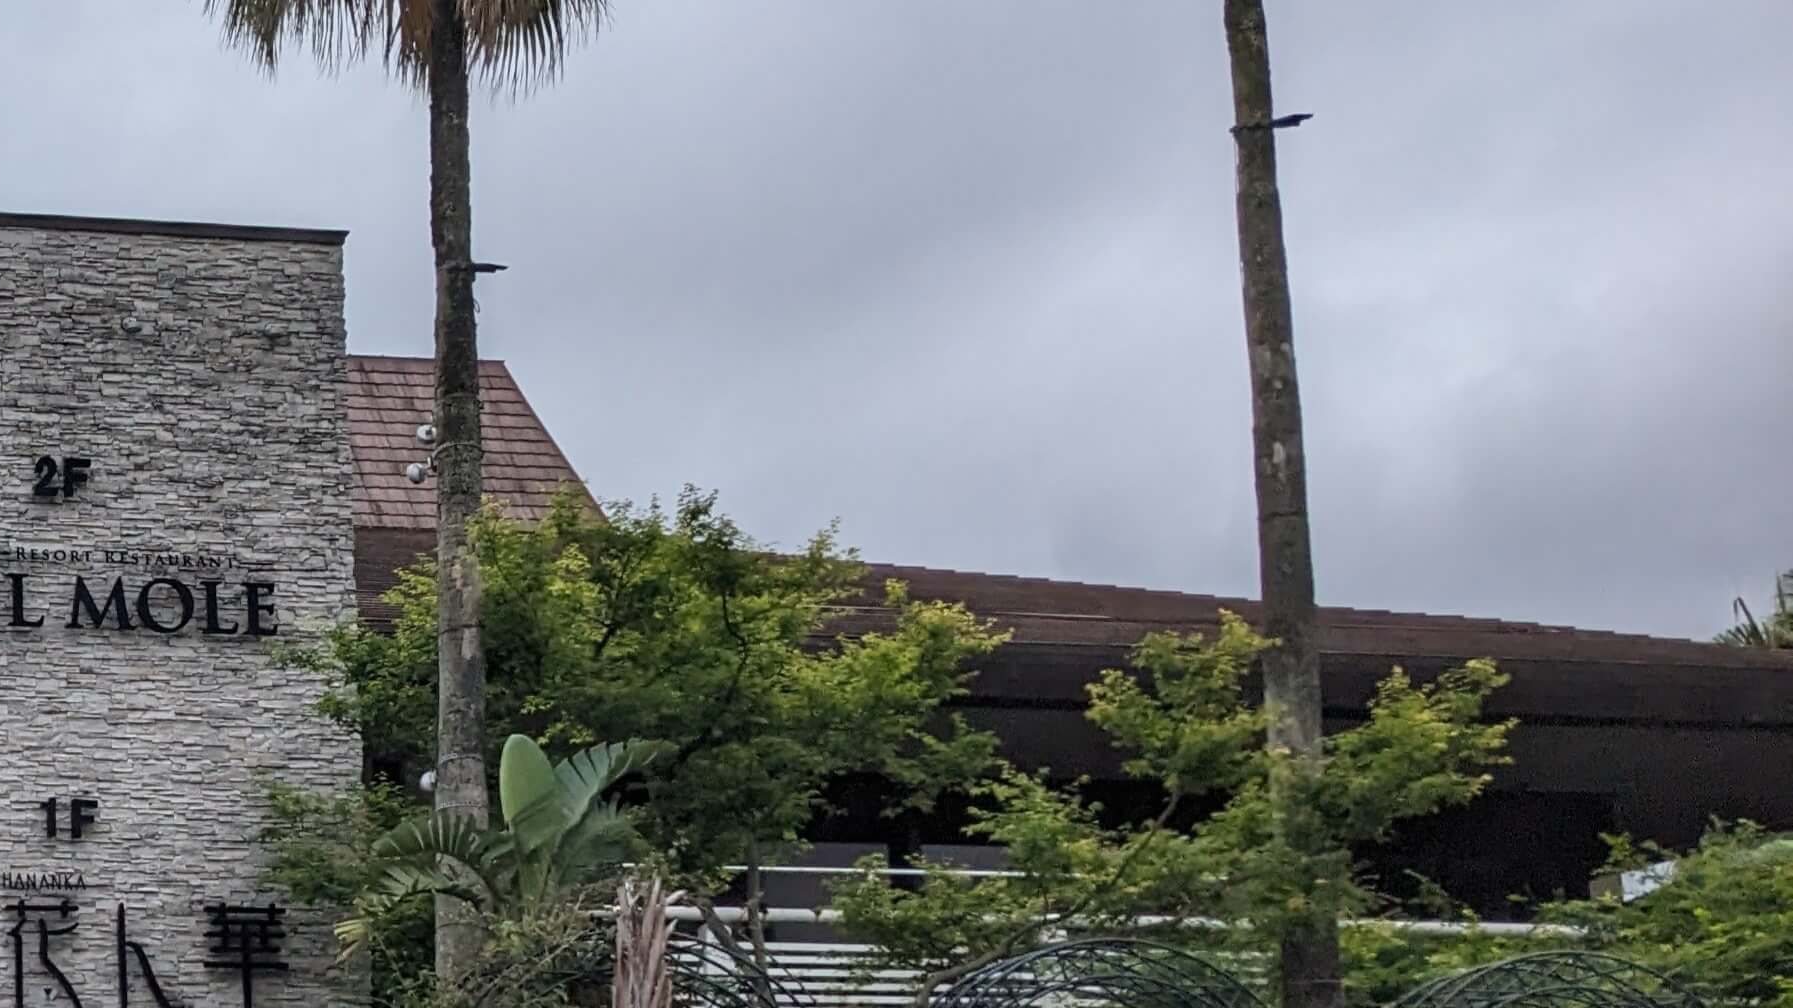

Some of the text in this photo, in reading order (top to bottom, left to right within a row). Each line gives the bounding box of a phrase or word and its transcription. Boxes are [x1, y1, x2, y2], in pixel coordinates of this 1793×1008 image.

[32, 455, 92, 498] 2F
[15, 546, 236, 569] RESORT RESTAURANT
[64, 574, 279, 636] MOLE
[41, 797, 98, 838] 1F
[2, 871, 87, 890] HANANKA
